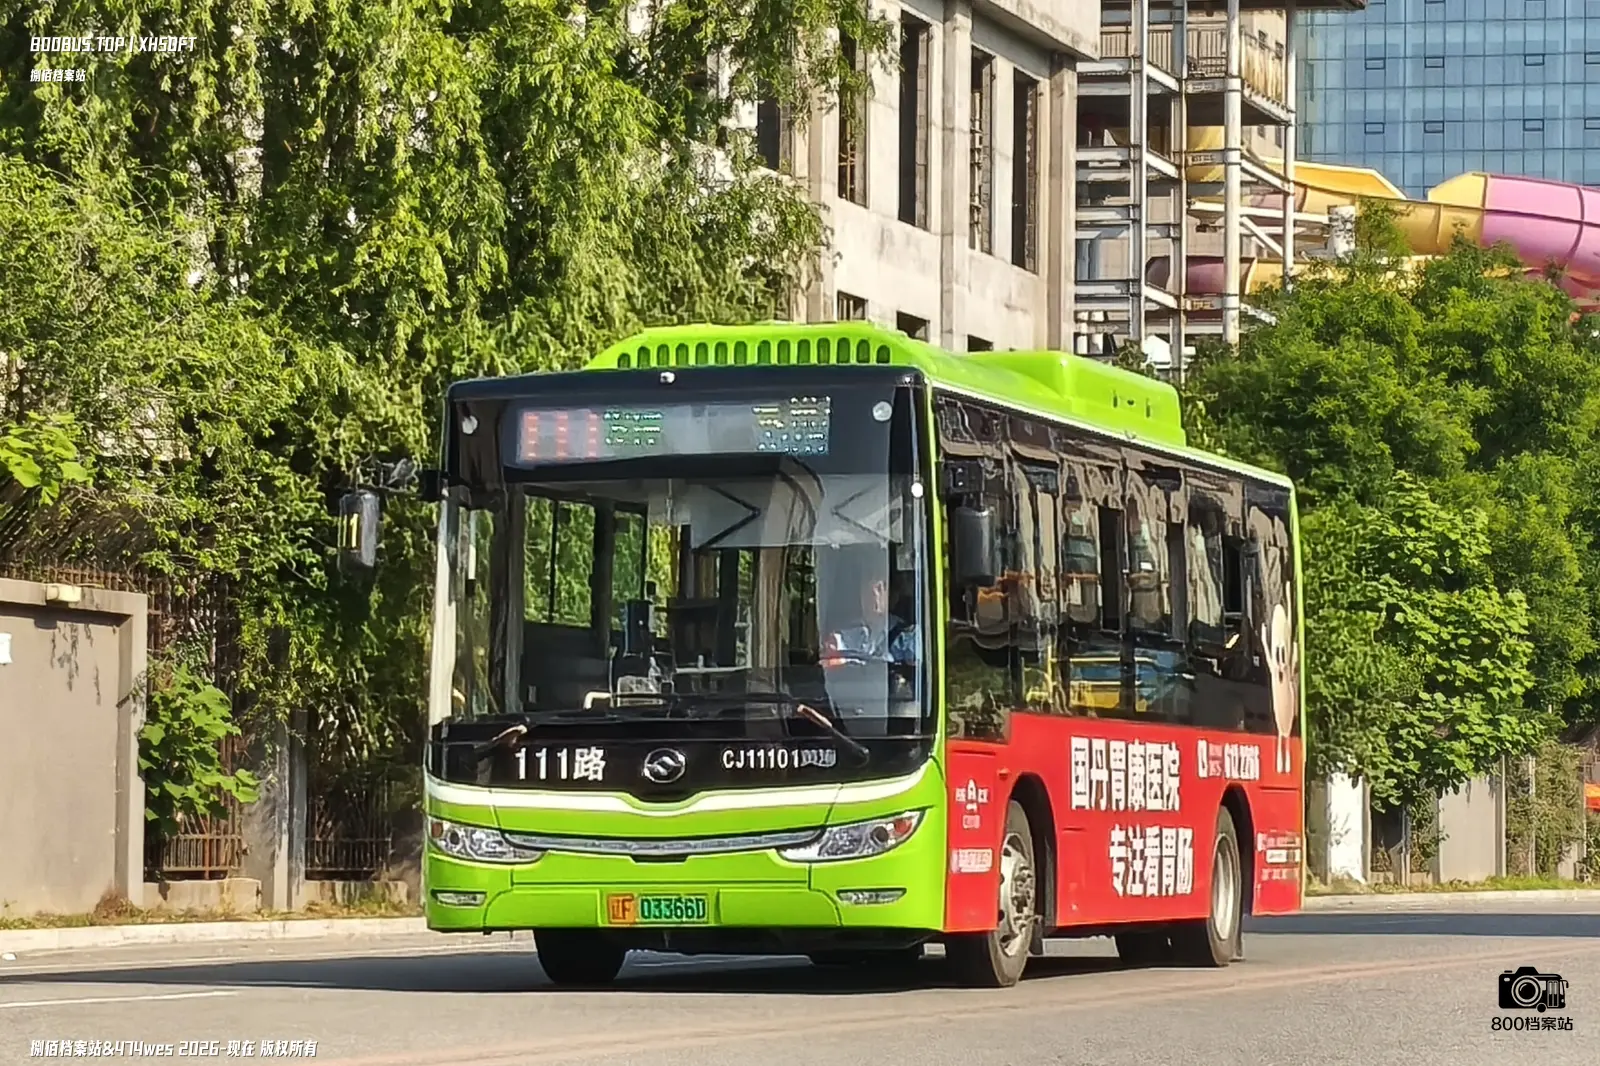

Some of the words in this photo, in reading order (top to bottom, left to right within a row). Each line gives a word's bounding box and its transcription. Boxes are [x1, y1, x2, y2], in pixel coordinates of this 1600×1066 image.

[515, 746, 606, 781] 111路
[722, 747, 799, 769] CJ11101
[1109, 824, 1193, 897] 专注看胃肠
